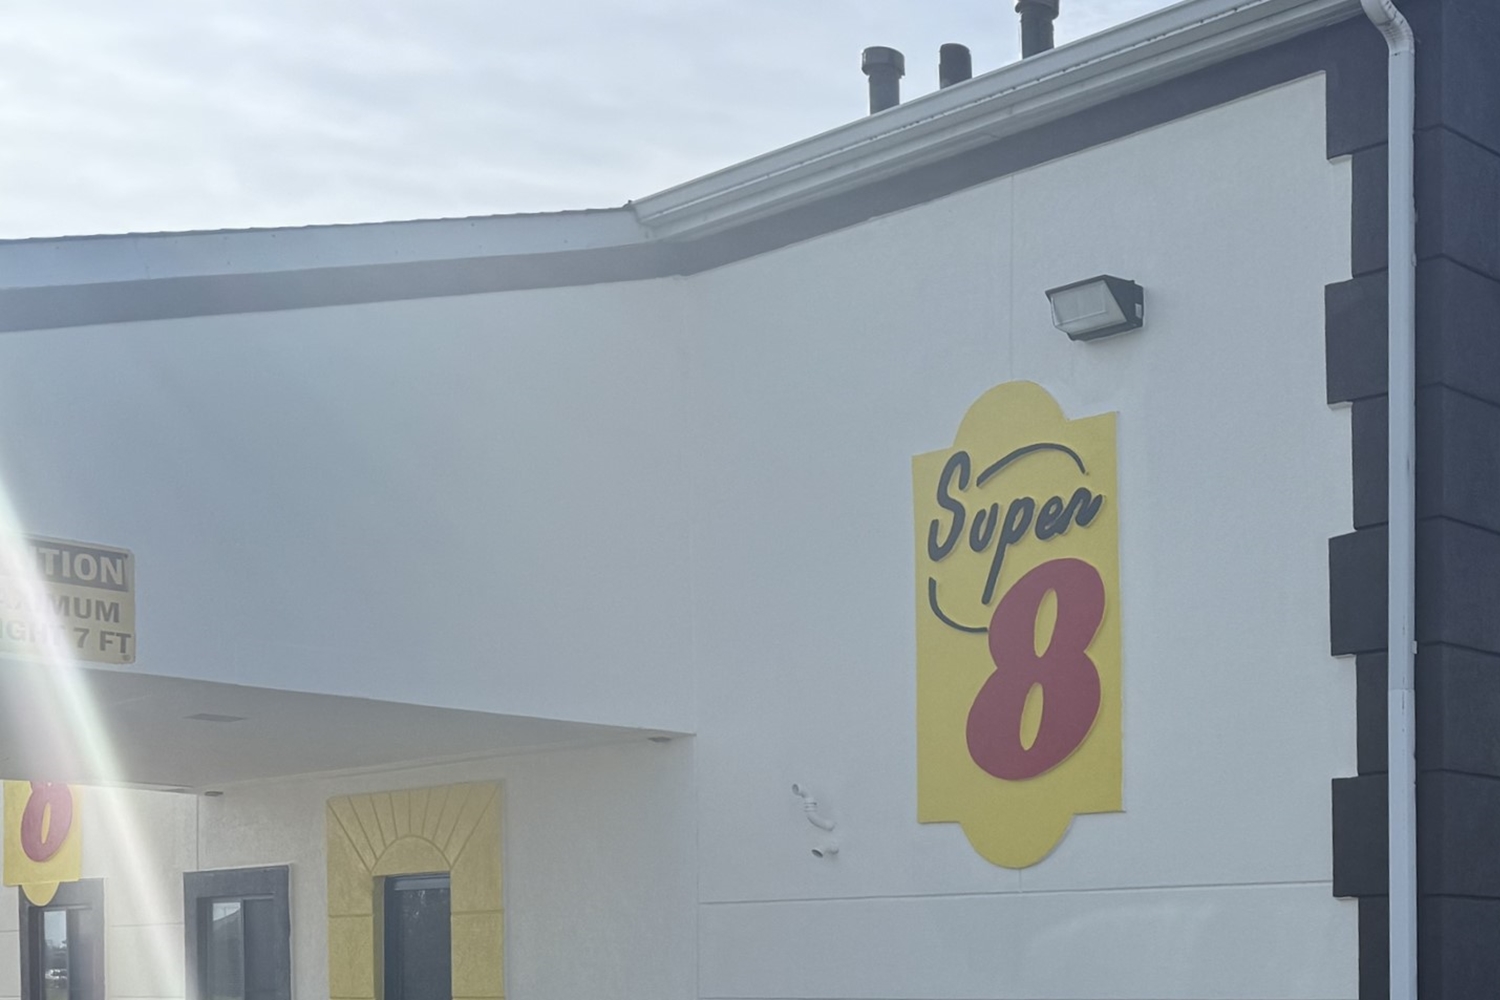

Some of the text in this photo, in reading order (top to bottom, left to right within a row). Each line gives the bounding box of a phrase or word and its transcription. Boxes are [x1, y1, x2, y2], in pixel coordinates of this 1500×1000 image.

[31, 545, 124, 586] TION
[927, 450, 1106, 605] Super
[73, 626, 91, 649] 7
[99, 629, 132, 655] FT
[965, 557, 1106, 781] 8
